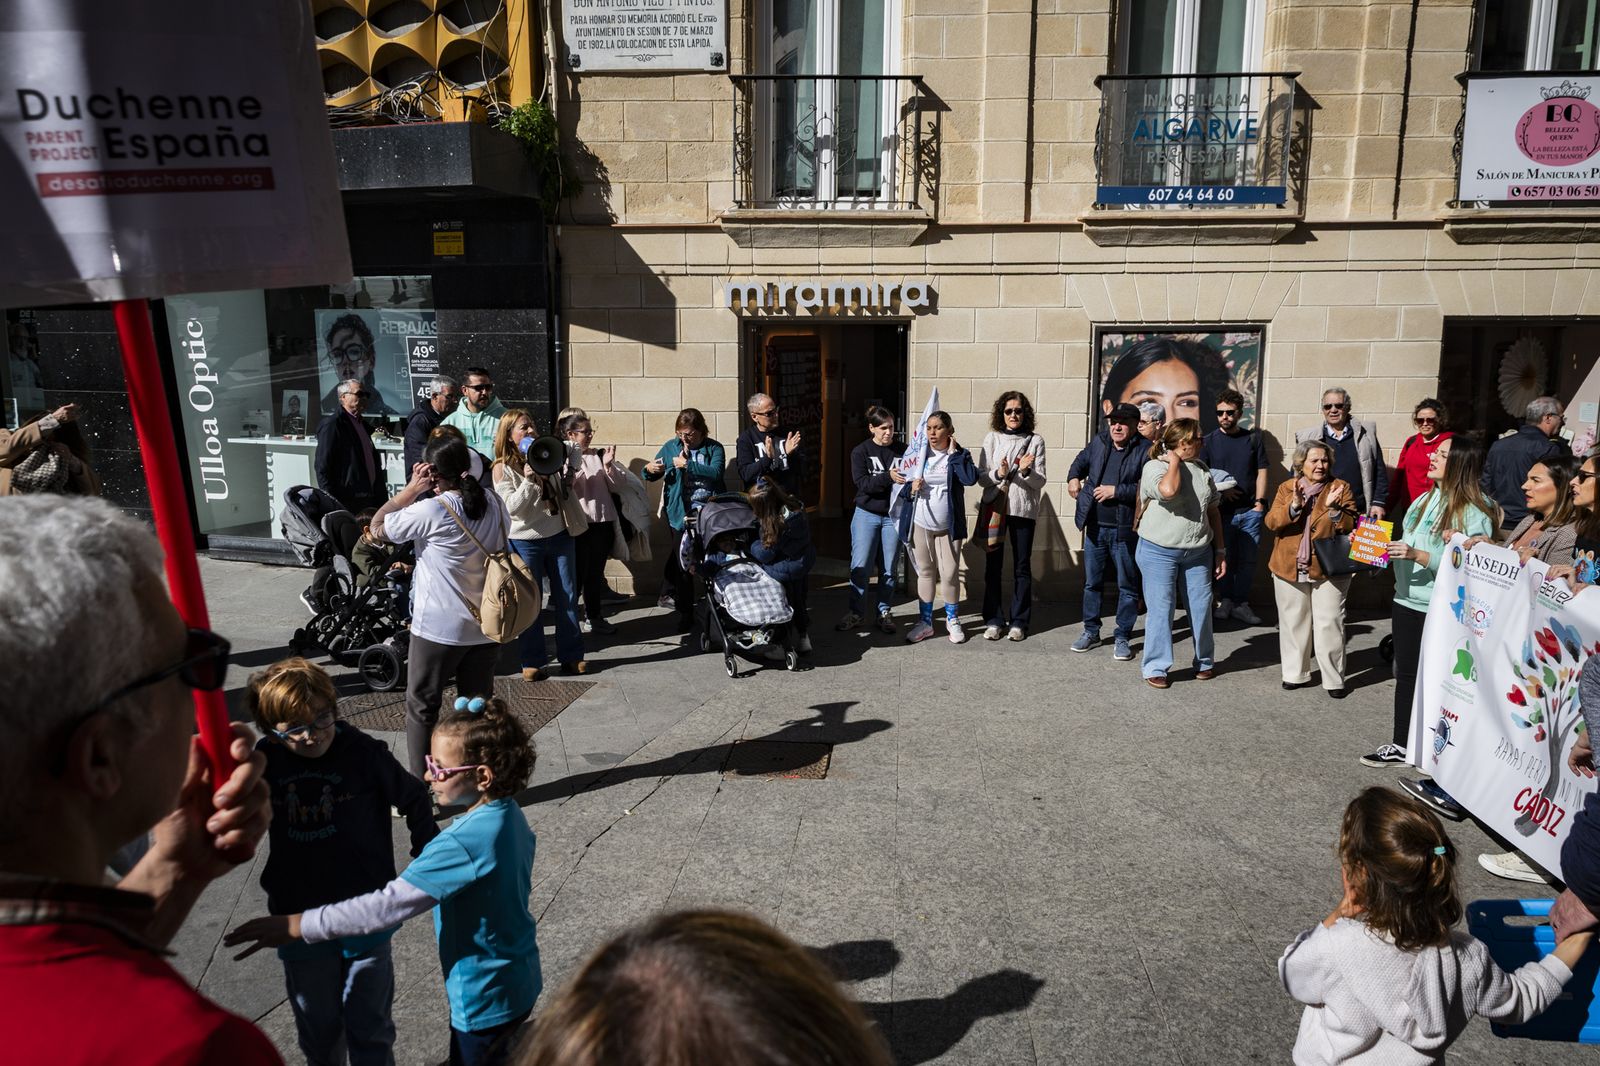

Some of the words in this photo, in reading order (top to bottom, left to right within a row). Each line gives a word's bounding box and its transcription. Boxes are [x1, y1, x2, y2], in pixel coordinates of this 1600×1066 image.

[570, 16, 588, 24] PARA
[590, 15, 616, 24] HONRAR
[618, 15, 626, 24] SU
[628, 14, 658, 24] MEMORIA
[688, 14, 696, 23] EL
[576, 27, 625, 37] AYUNTAMIENTO
[626, 27, 635, 36] EN
[663, 26, 671, 35] DE
[674, 26, 678, 35] 7
[680, 26, 689, 35] DE
[690, 26, 714, 35] MARZO
[578, 40, 587, 49] DE
[617, 39, 656, 48] COLOCACION
[659, 39, 667, 48] DE
[669, 38, 685, 48] ESTA
[16, 88, 262, 121] Duchenne
[1546, 104, 1582, 123] BQ
[25, 130, 84, 145] PARENT
[1133, 118, 1258, 141] ALGARVE
[30, 146, 99, 161] PROJECT
[103, 126, 270, 164] España
[1146, 152, 1184, 163] REAL
[1191, 151, 1240, 164] ESTATE
[49, 172, 263, 191] desafioduchenne.org
[1591, 168, 1600, 179] P
[1148, 189, 1175, 201] 607
[1177, 189, 1193, 201] 64
[1197, 189, 1213, 201] 64
[1217, 189, 1234, 201] 60
[1524, 186, 1545, 197] 657
[1549, 186, 1563, 196] 03
[1567, 186, 1581, 196] 06
[1584, 185, 1599, 196] 50
[726, 280, 930, 307] miramira
[379, 321, 437, 335] REBAJAS
[412, 345, 435, 358] 49€
[182, 317, 219, 413] Optic
[199, 417, 229, 503] Ulloa
[1464, 553, 1520, 580] ANSEDH
[1494, 737, 1526, 771] RARAS
[1526, 753, 1547, 784] PERO
[1513, 786, 1565, 838] CÁDIZ
[288, 824, 337, 842] UNIPER
